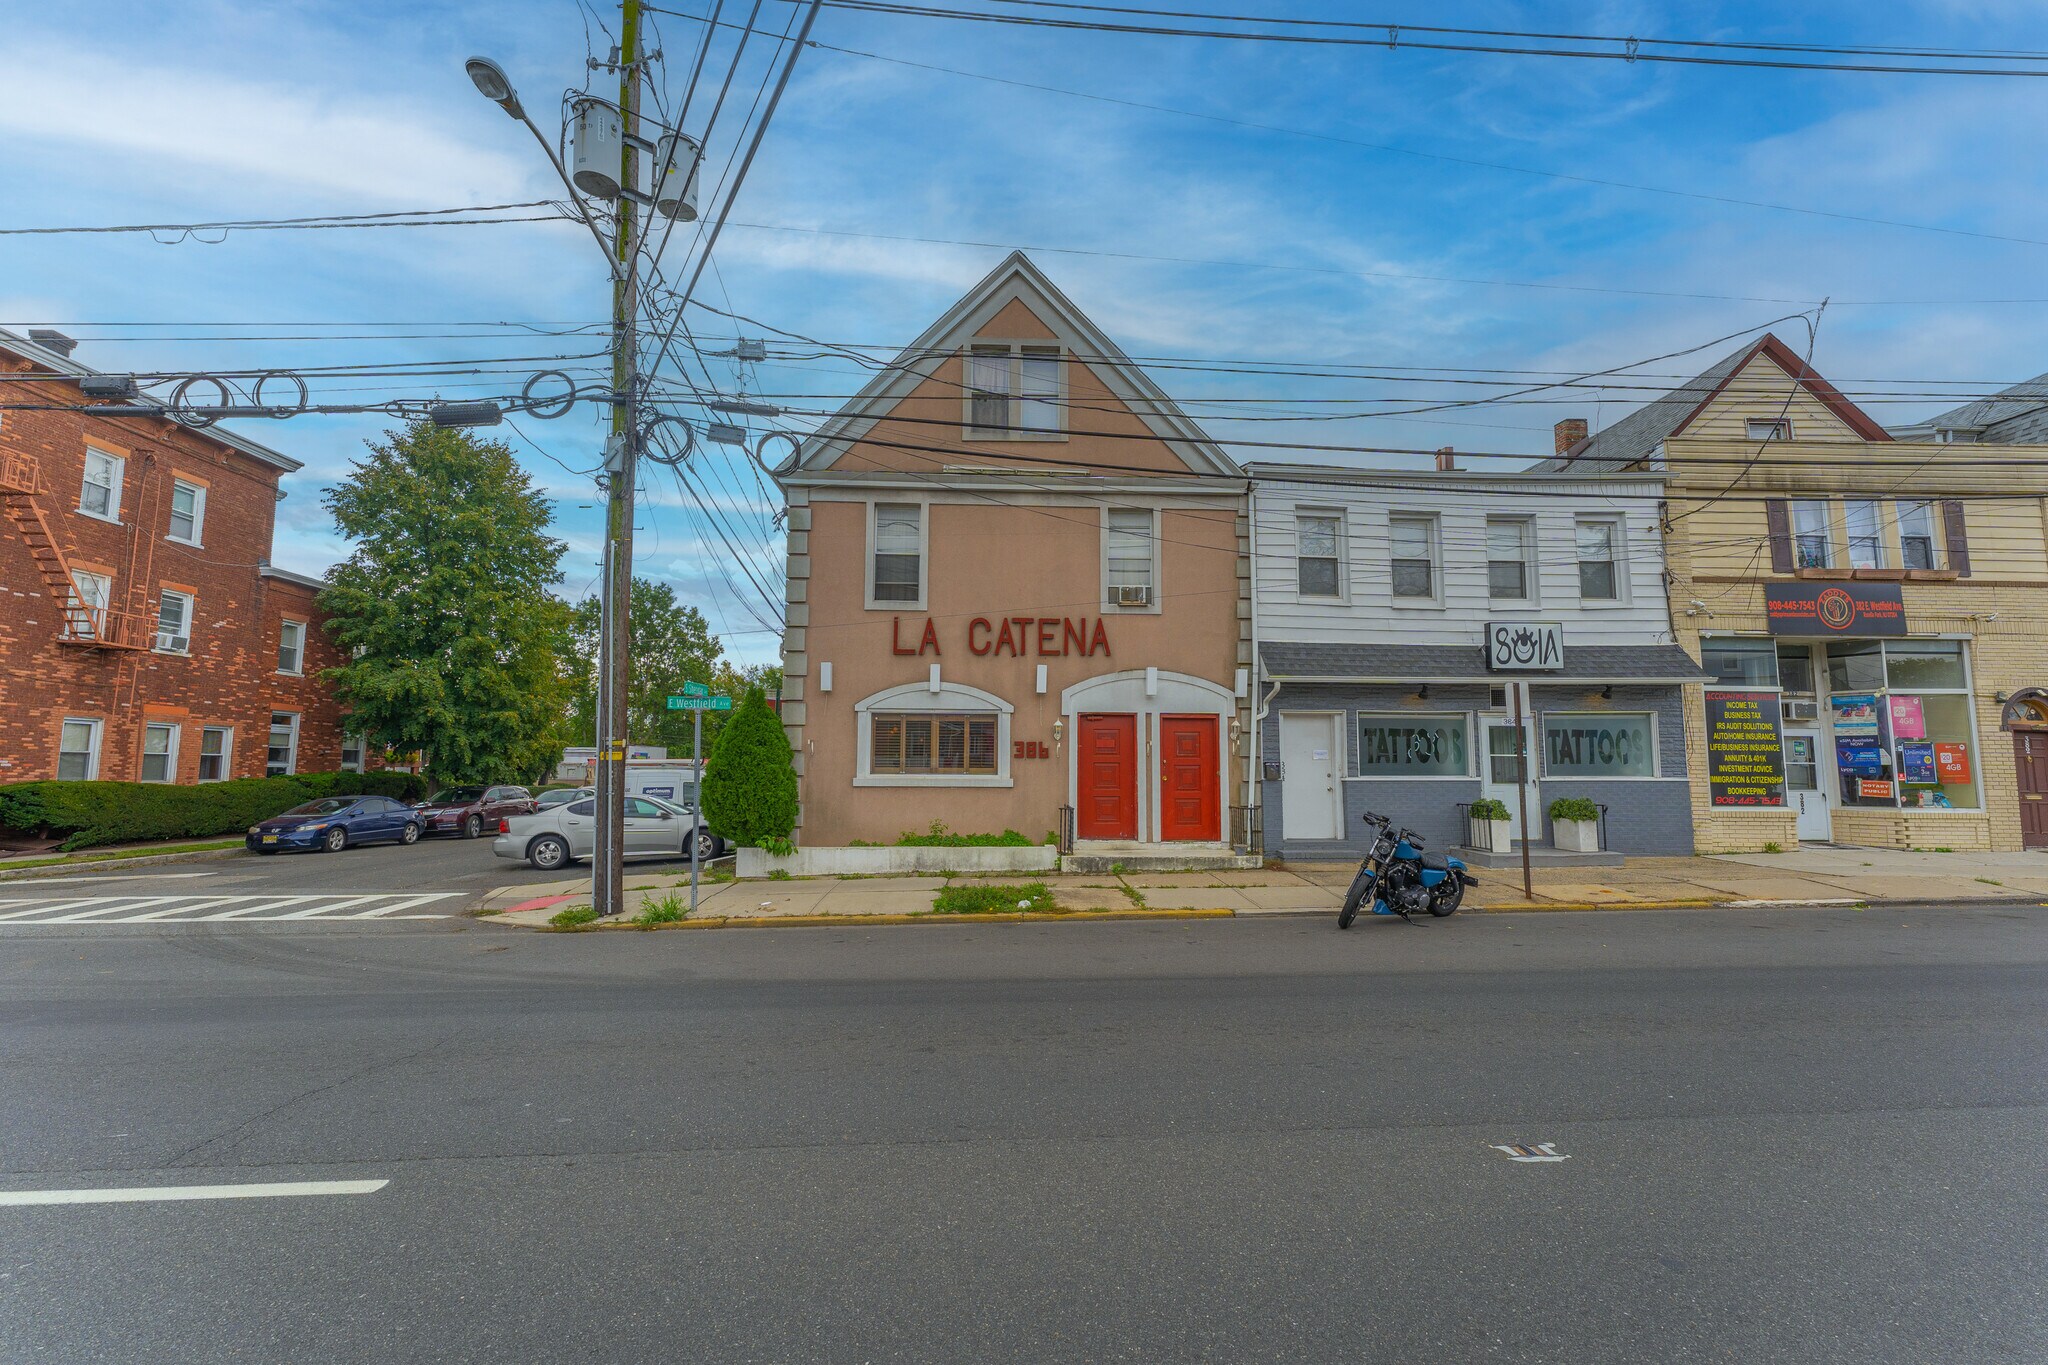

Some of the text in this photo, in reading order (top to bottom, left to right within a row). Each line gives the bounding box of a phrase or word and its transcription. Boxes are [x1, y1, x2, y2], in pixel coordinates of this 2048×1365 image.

[1768, 600, 1816, 610] 908-445-7543
[893, 617, 1111, 656] LA CATENA
[669, 699, 673, 708] E
[676, 698, 716, 708] Westfield
[1014, 741, 1049, 759] 386
[1364, 728, 1462, 764] TATTOOS
[1548, 728, 1644, 765] TATTOOS
[1716, 796, 1782, 804] 908-445-7543
